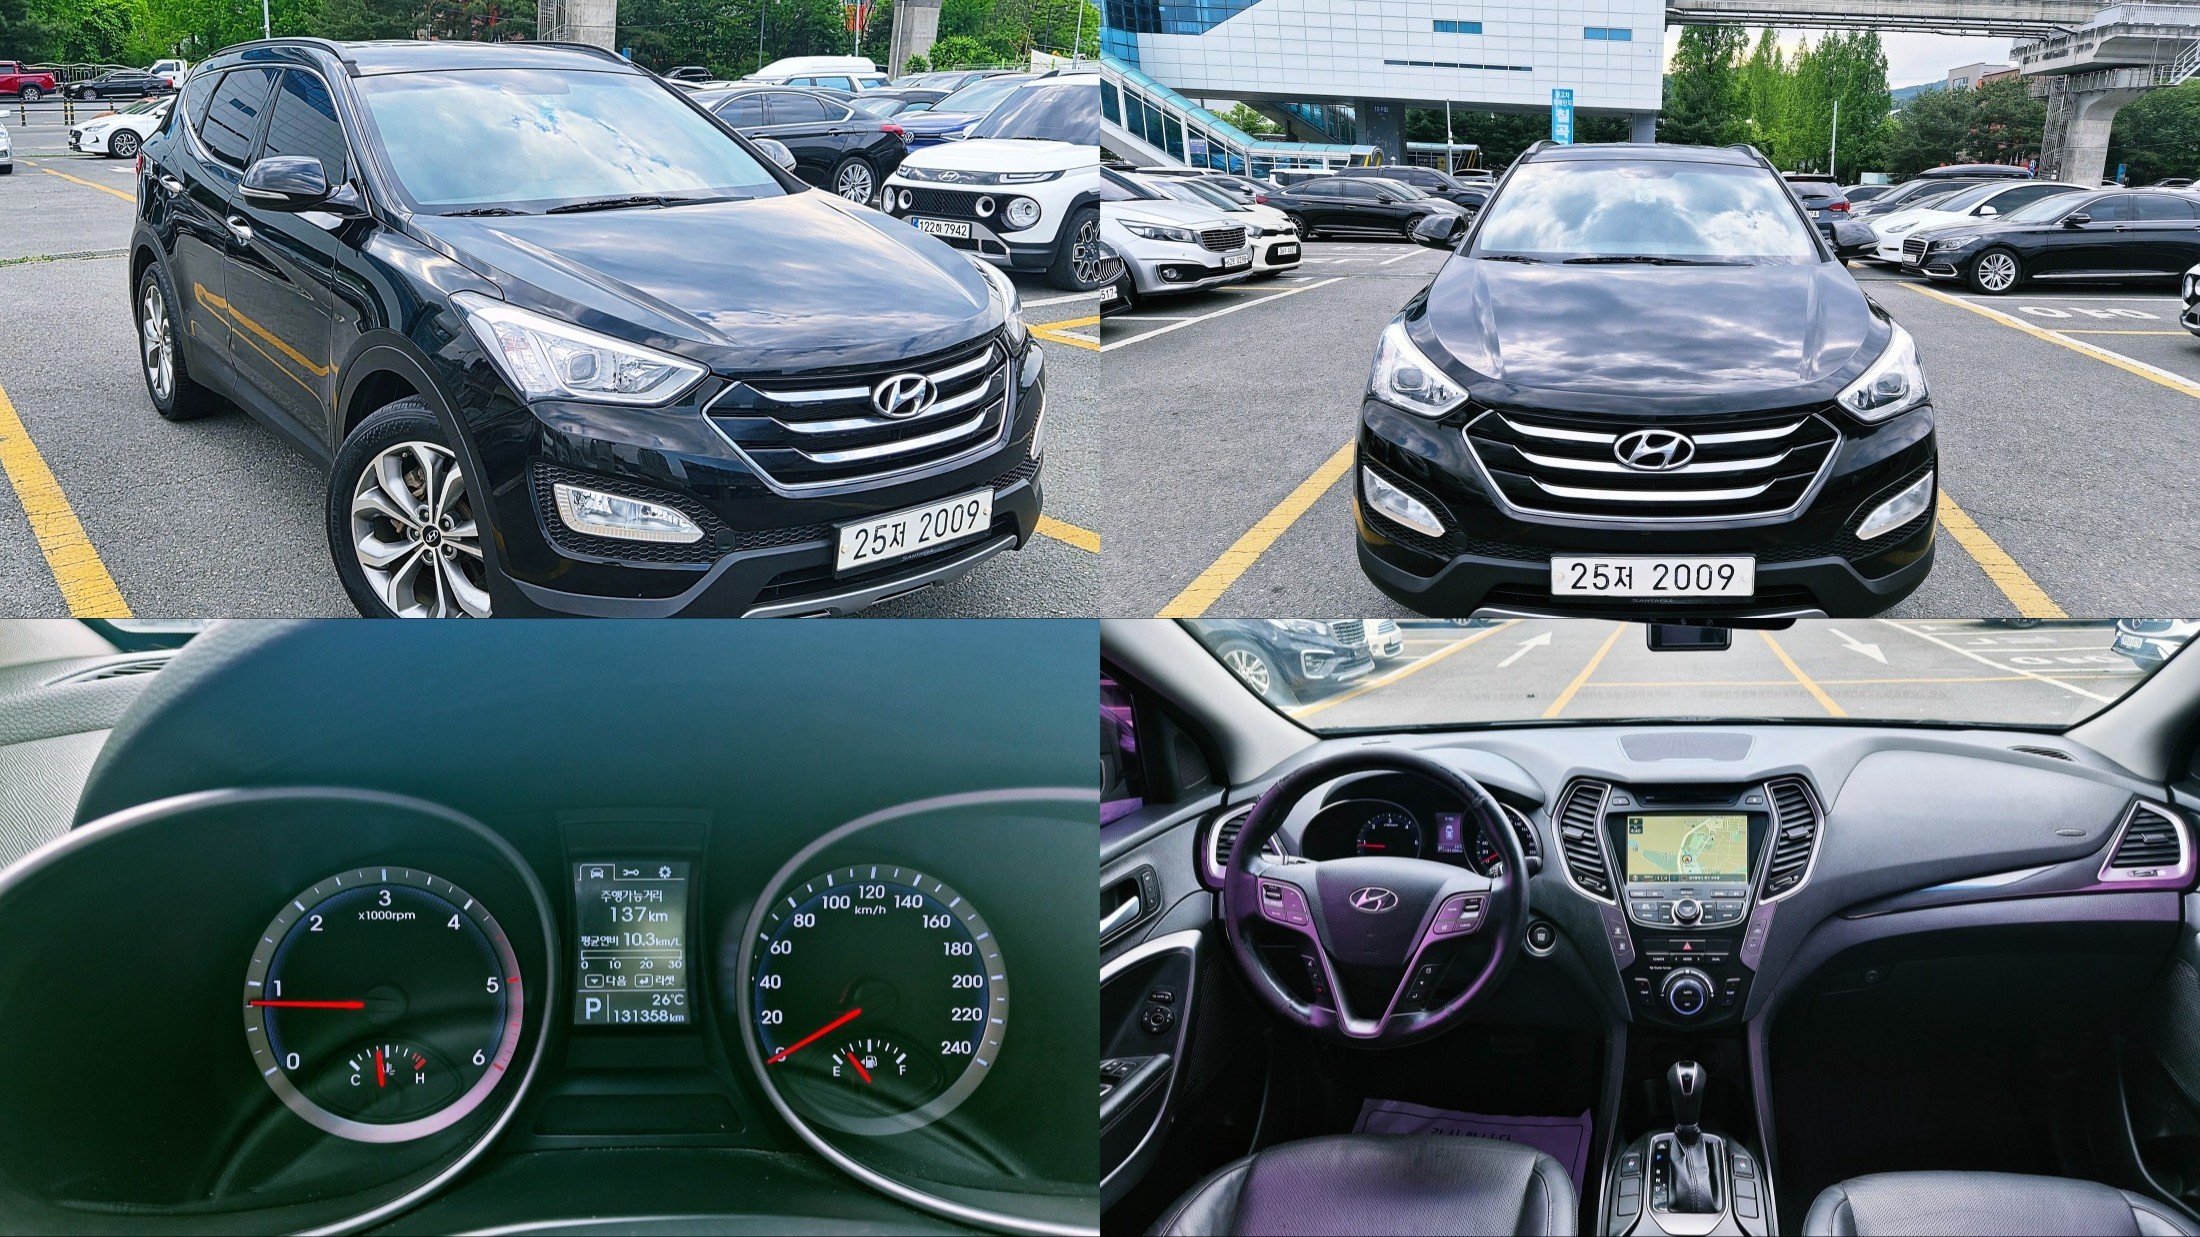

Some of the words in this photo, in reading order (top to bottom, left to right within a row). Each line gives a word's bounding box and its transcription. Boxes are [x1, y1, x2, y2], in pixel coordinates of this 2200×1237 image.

[944, 223, 967, 237] 7942
[853, 521, 906, 561] 25저
[918, 500, 980, 544] 2009
[1571, 562, 1633, 590] 25저
[1652, 563, 1735, 591] 2009
[378, 889, 392, 906] 3
[601, 890, 663, 903] 주행가능거리
[858, 884, 885, 899] 120
[822, 895, 851, 910] 100
[894, 894, 923, 909] 140
[358, 910, 416, 921] x1000rpm
[854, 905, 887, 915] km/h
[310, 915, 323, 931] 2
[447, 914, 461, 930] 4
[793, 913, 816, 928] 80
[922, 914, 951, 929] 160
[581, 935, 619, 947] 평균연비
[770, 940, 792, 954] 60
[943, 941, 973, 956] 180
[581, 961, 589, 970] 0
[609, 961, 621, 970] 10
[639, 961, 653, 970] 20
[668, 961, 682, 970] 30
[273, 980, 281, 997] 1
[486, 977, 499, 994] 5
[606, 975, 627, 987] 다음
[655, 975, 675, 987] 리셋
[759, 974, 782, 989] 40
[951, 974, 984, 989] 200
[585, 997, 602, 1020] P
[652, 994, 684, 1006] 26°C
[951, 1007, 983, 1021] 220
[761, 1010, 783, 1025] 20
[941, 1040, 972, 1055] 240
[286, 1052, 300, 1070] 0
[472, 1049, 486, 1066] 6
[833, 1065, 841, 1077] E
[899, 1064, 907, 1076] F
[350, 1074, 361, 1086] C
[415, 1072, 425, 1084] H
